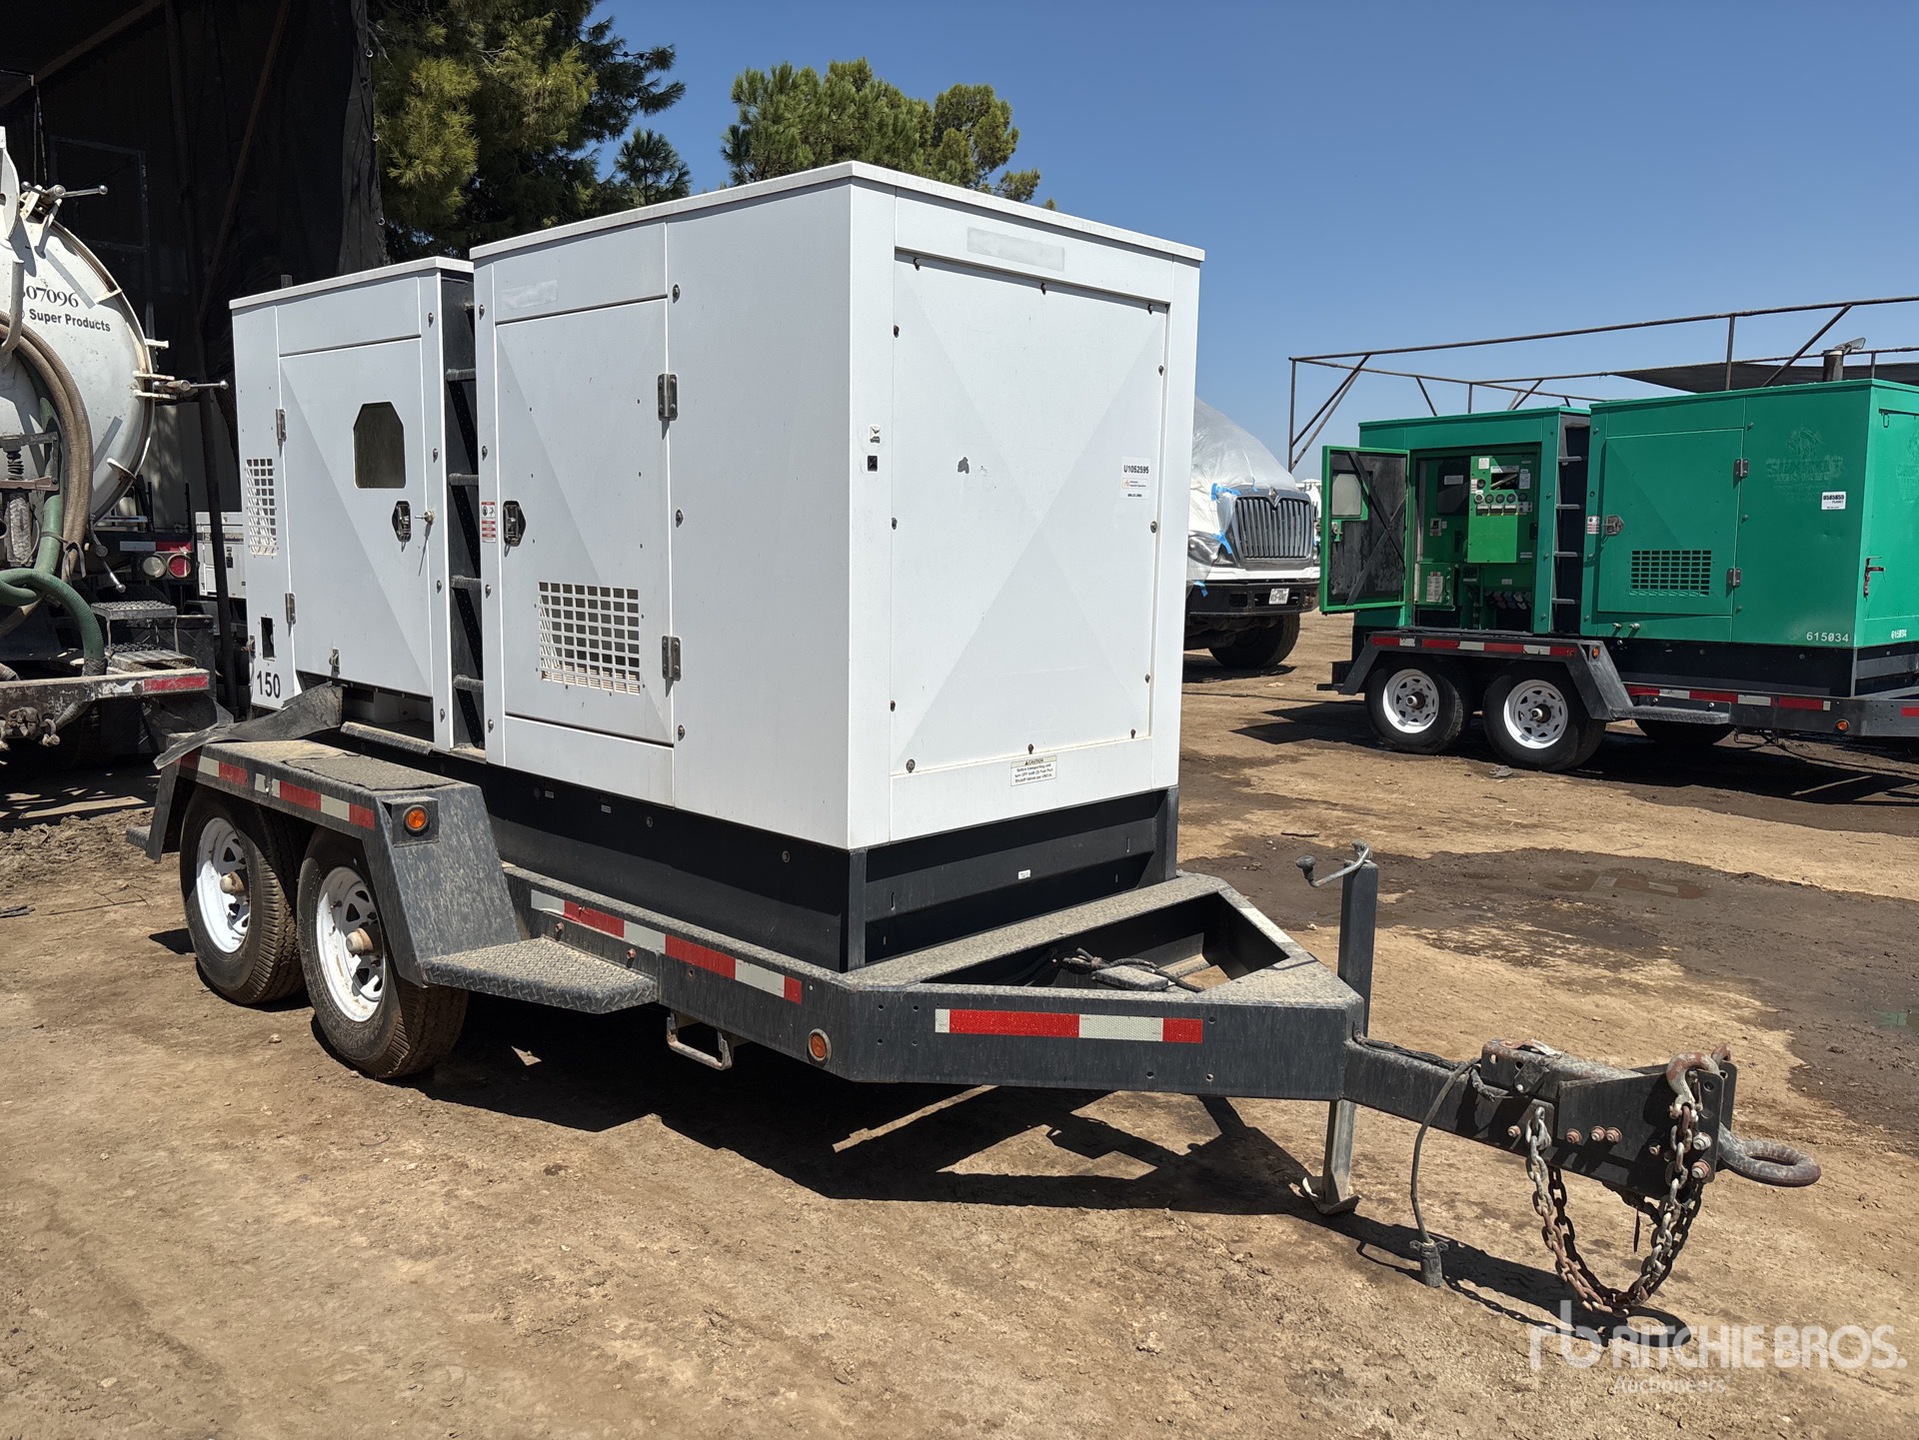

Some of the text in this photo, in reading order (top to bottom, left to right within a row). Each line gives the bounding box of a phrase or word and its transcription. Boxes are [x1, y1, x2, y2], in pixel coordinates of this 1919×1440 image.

[23, 285, 79, 308] 07096
[29, 308, 111, 332] Super Products
[1806, 631, 1849, 643] 615034
[257, 670, 281, 699] 150
